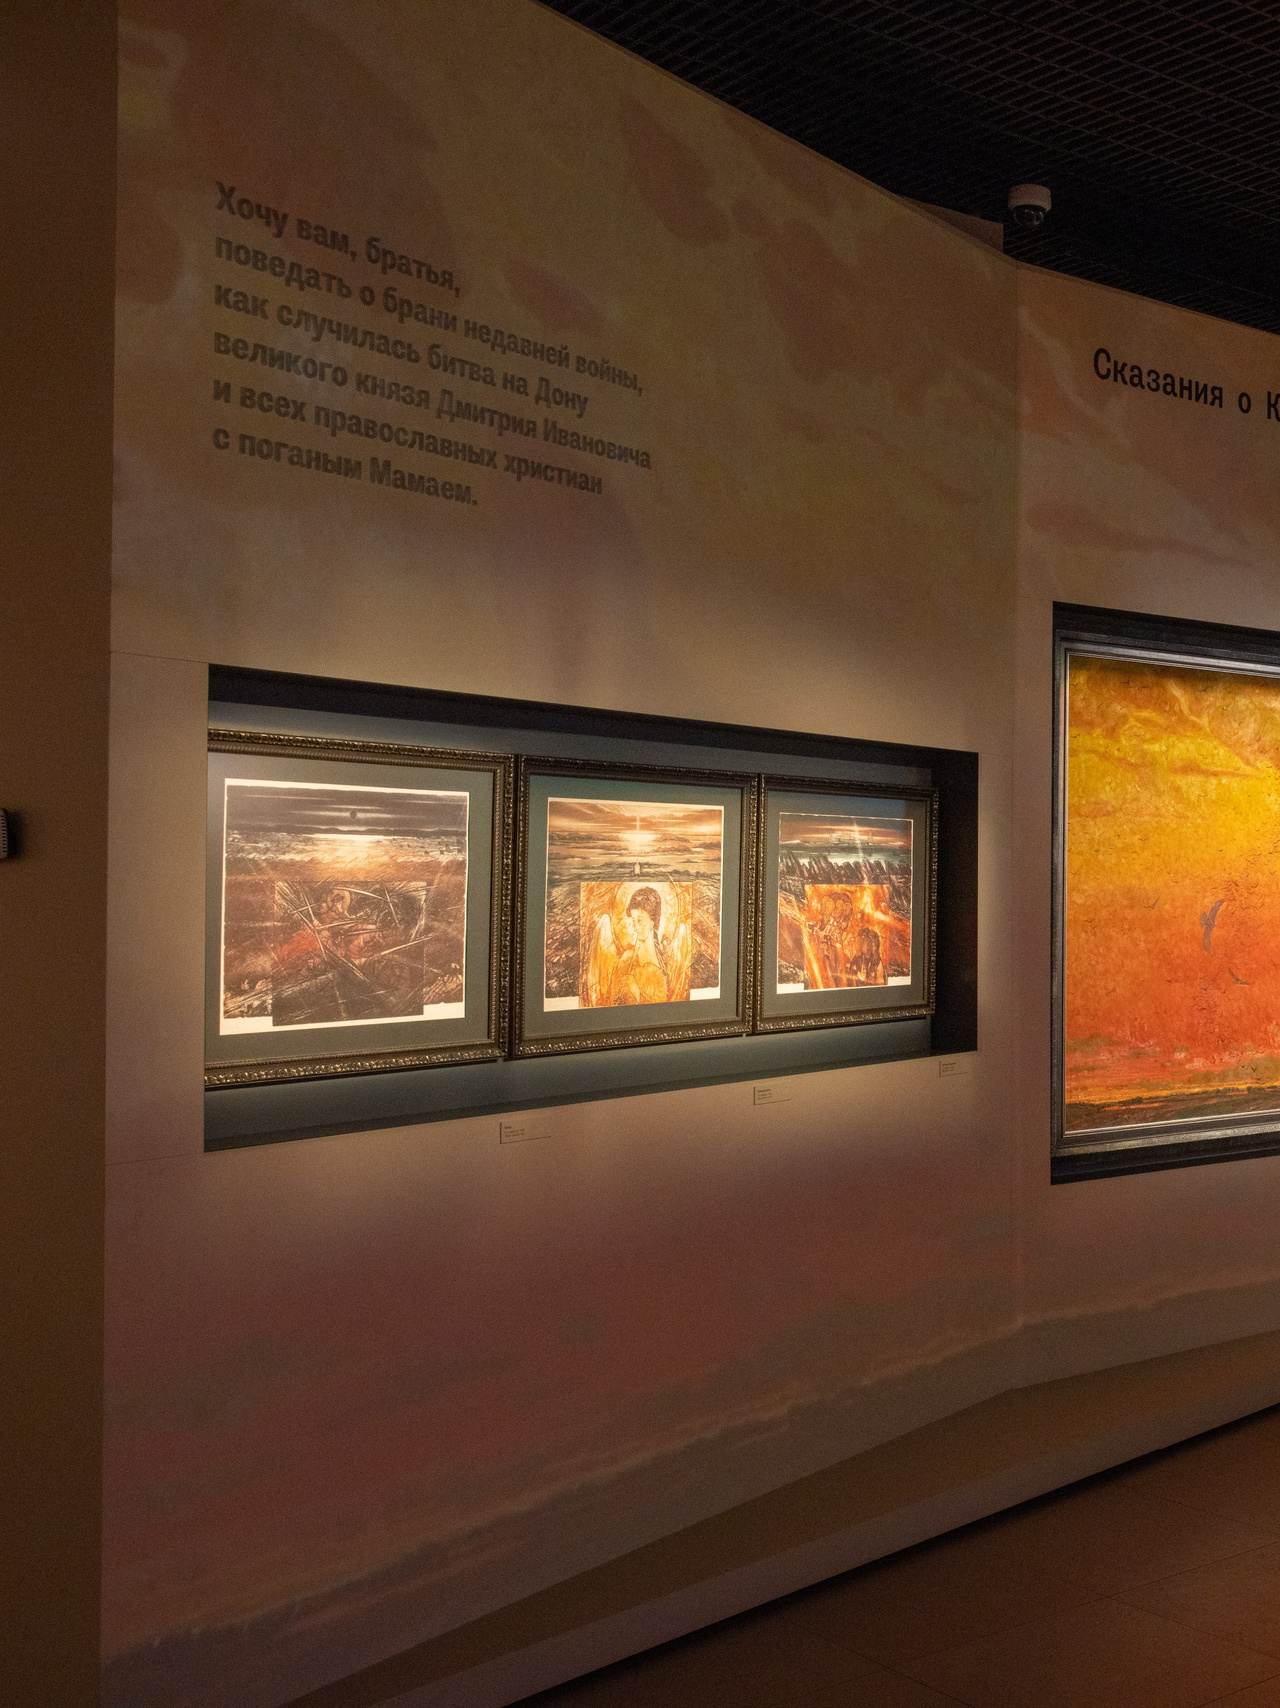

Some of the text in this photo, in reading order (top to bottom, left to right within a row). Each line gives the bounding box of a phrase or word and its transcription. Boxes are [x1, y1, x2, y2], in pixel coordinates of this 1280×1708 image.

[216, 182, 461, 298] Хочу вам, братья,
[214, 282, 588, 420] как случилась битва на Дону
[215, 235, 644, 396] поведать о брани недавней войны,
[214, 330, 652, 470] великого князя Дмитрия Ивановича
[214, 378, 603, 495] и всех православных христиан
[1093, 346, 1224, 408] Сказания
[1238, 391, 1252, 414] о
[213, 426, 479, 506] с поганым Мамаем.
